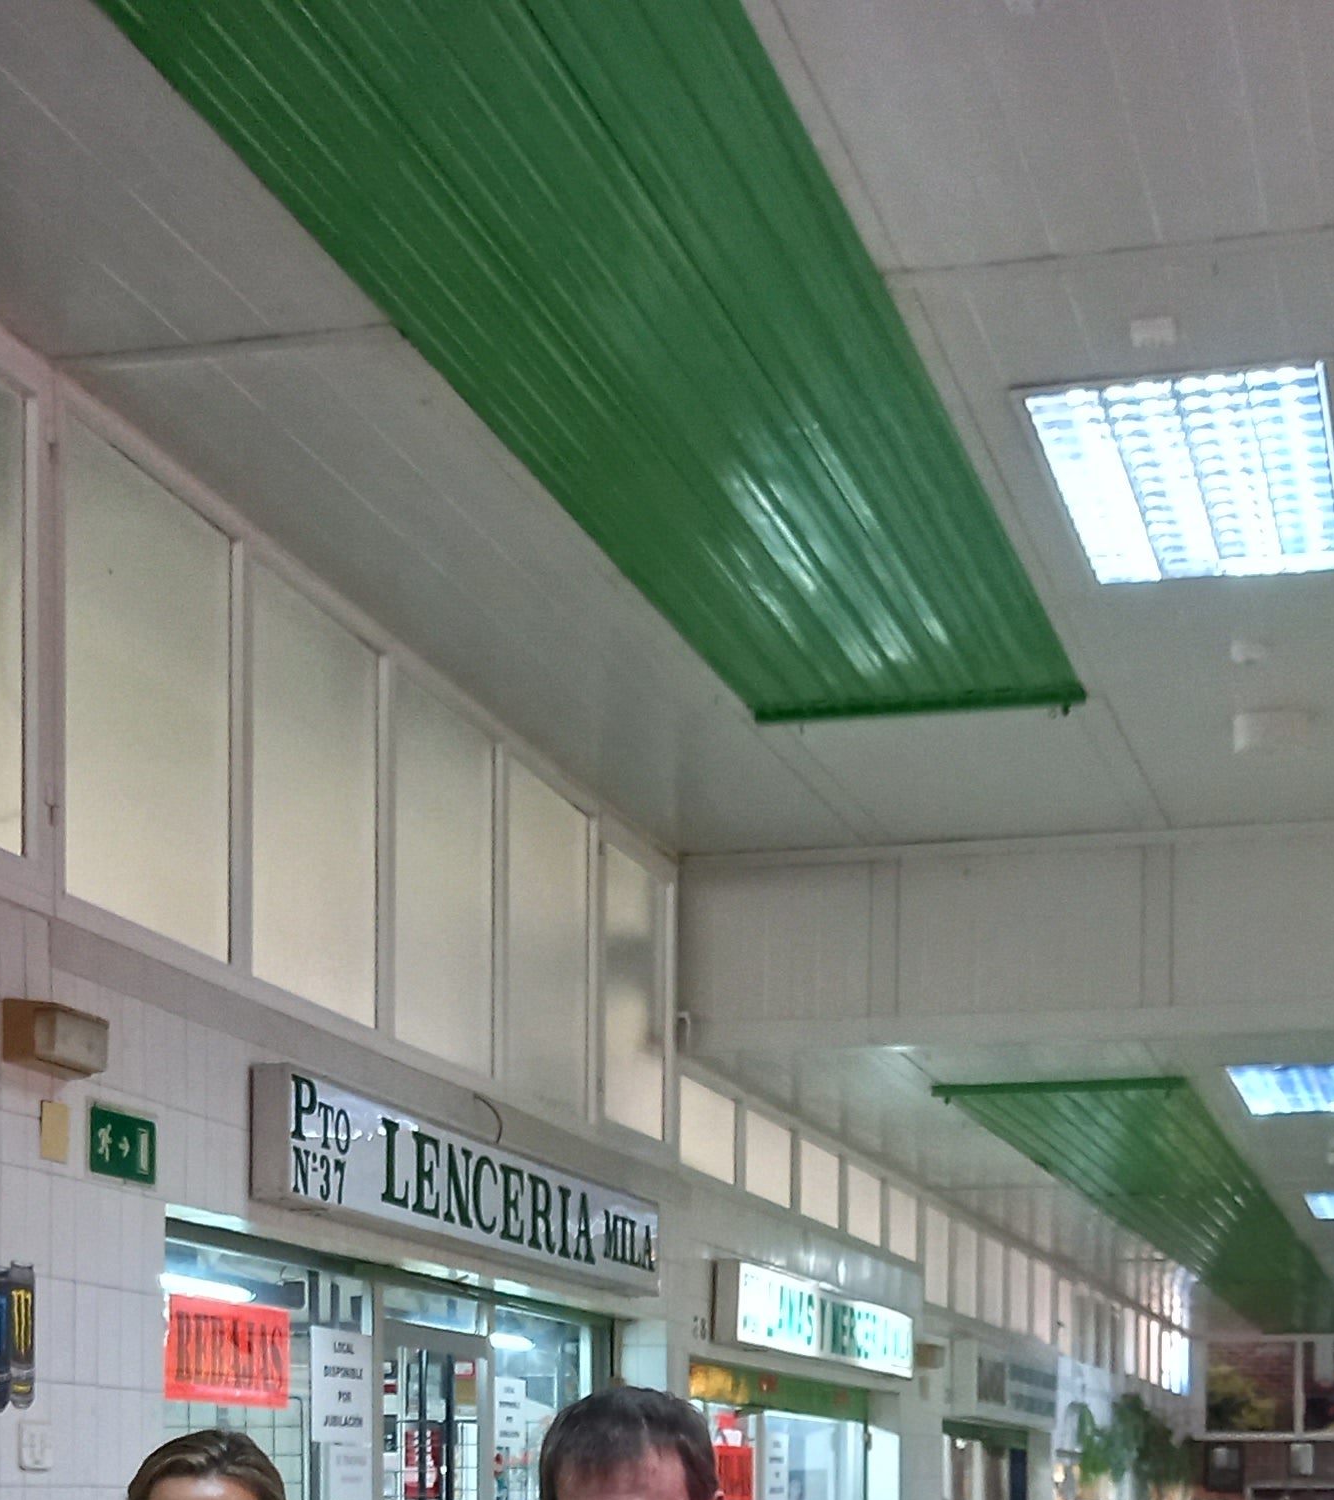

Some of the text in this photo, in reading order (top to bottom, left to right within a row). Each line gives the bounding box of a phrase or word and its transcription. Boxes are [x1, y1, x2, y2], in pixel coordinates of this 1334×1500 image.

[381, 1117, 596, 1265] LENCERIA
[603, 1209, 656, 1272] MILA
[174, 1310, 286, 1393] REBAJAS
